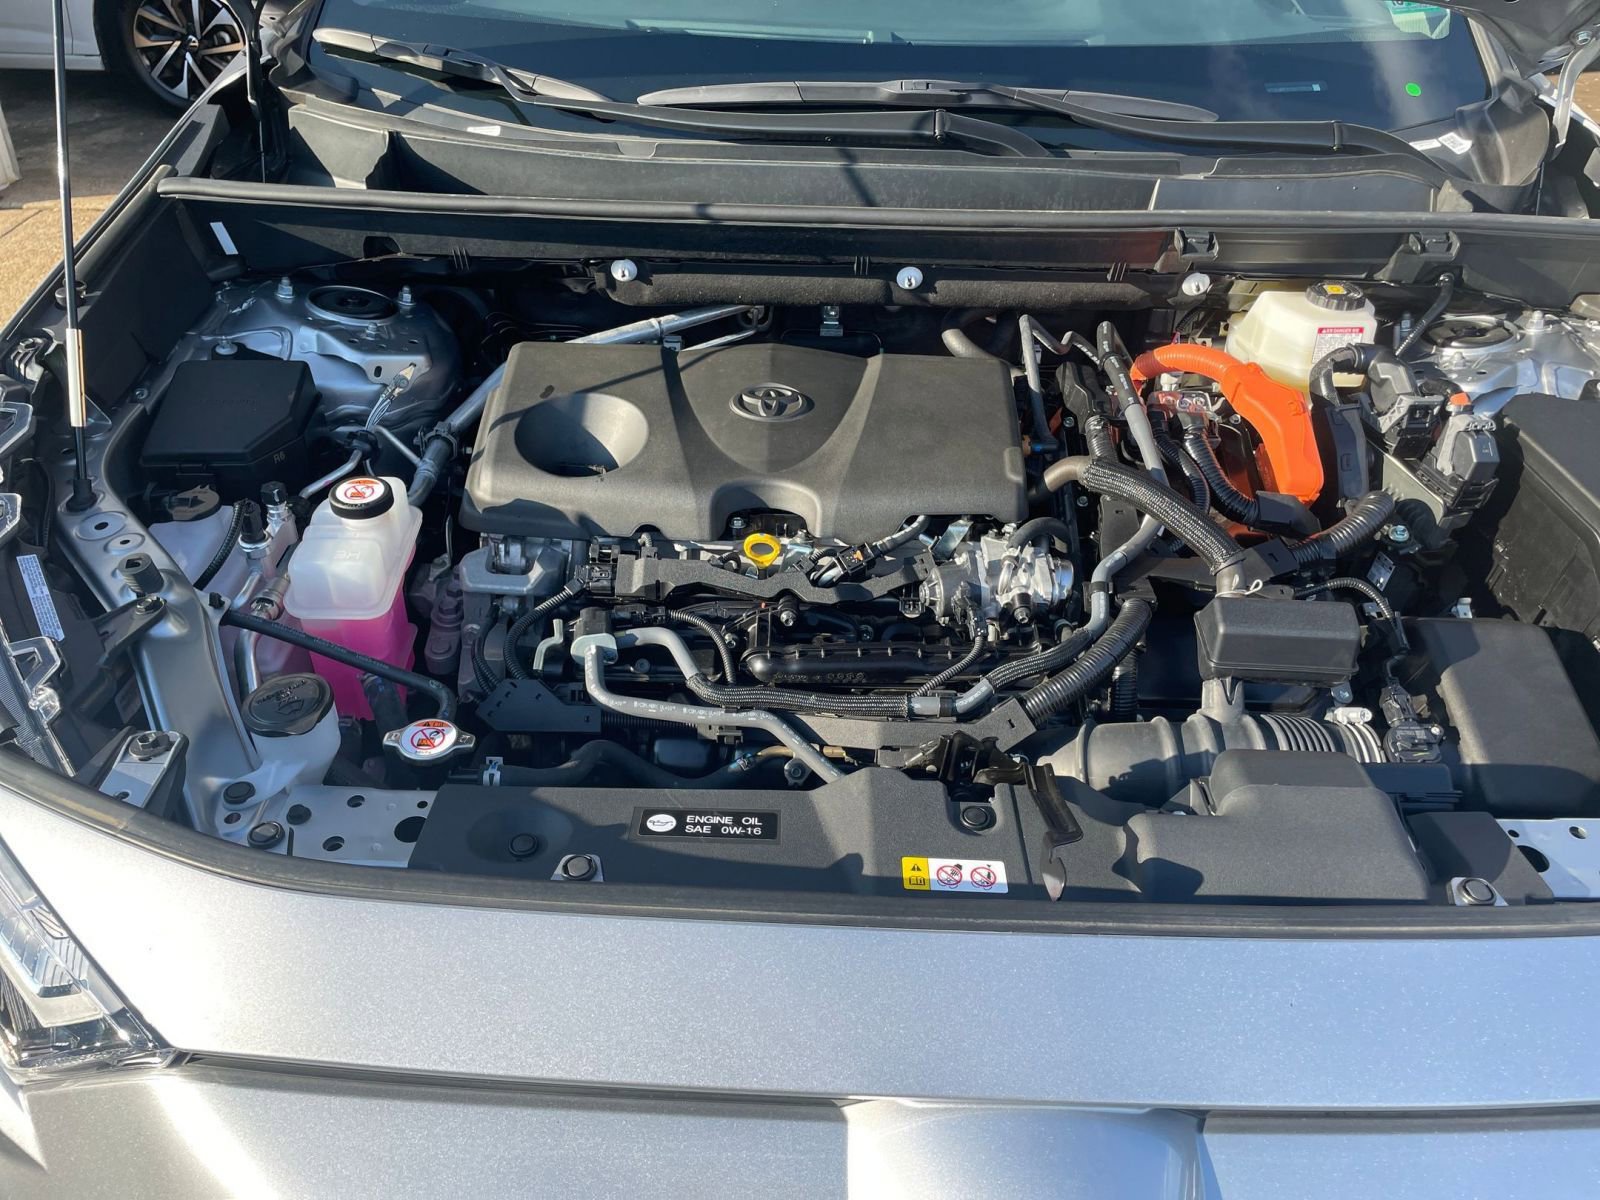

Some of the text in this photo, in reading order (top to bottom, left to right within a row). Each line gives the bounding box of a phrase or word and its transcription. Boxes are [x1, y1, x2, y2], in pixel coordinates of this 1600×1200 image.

[686, 815, 763, 826] ENGINE OIL
[685, 825, 762, 835] SAE 0W-16
